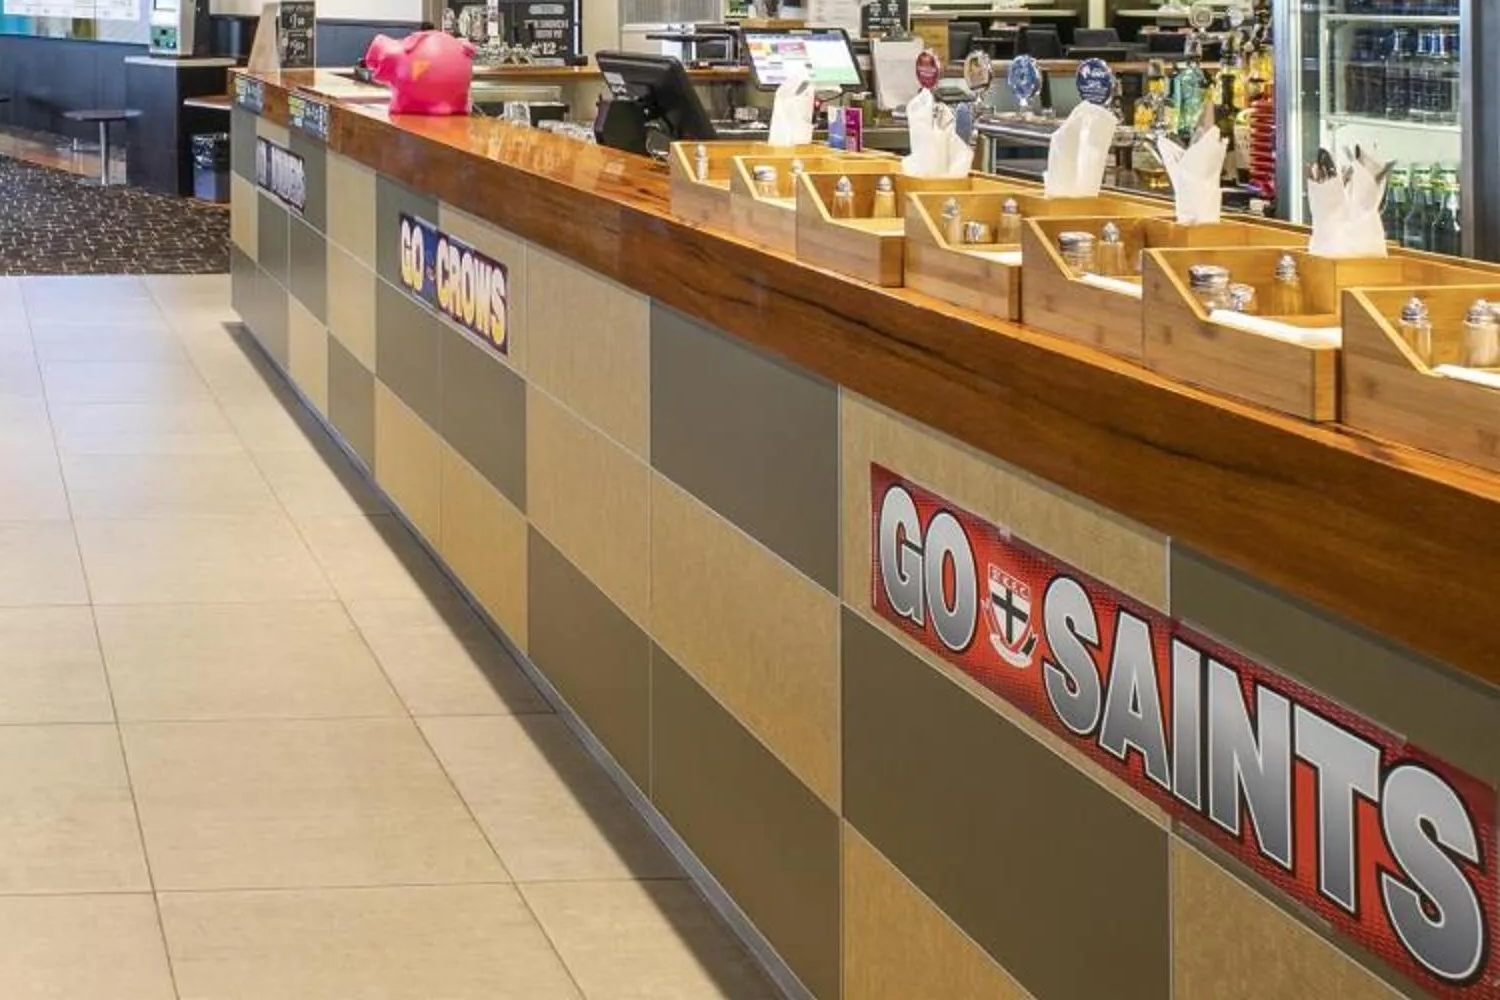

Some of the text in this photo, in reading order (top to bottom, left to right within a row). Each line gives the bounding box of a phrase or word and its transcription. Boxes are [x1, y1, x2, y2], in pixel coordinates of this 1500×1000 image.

[401, 219, 506, 345] GO CROWS
[879, 485, 1485, 981] GO SAINTS
